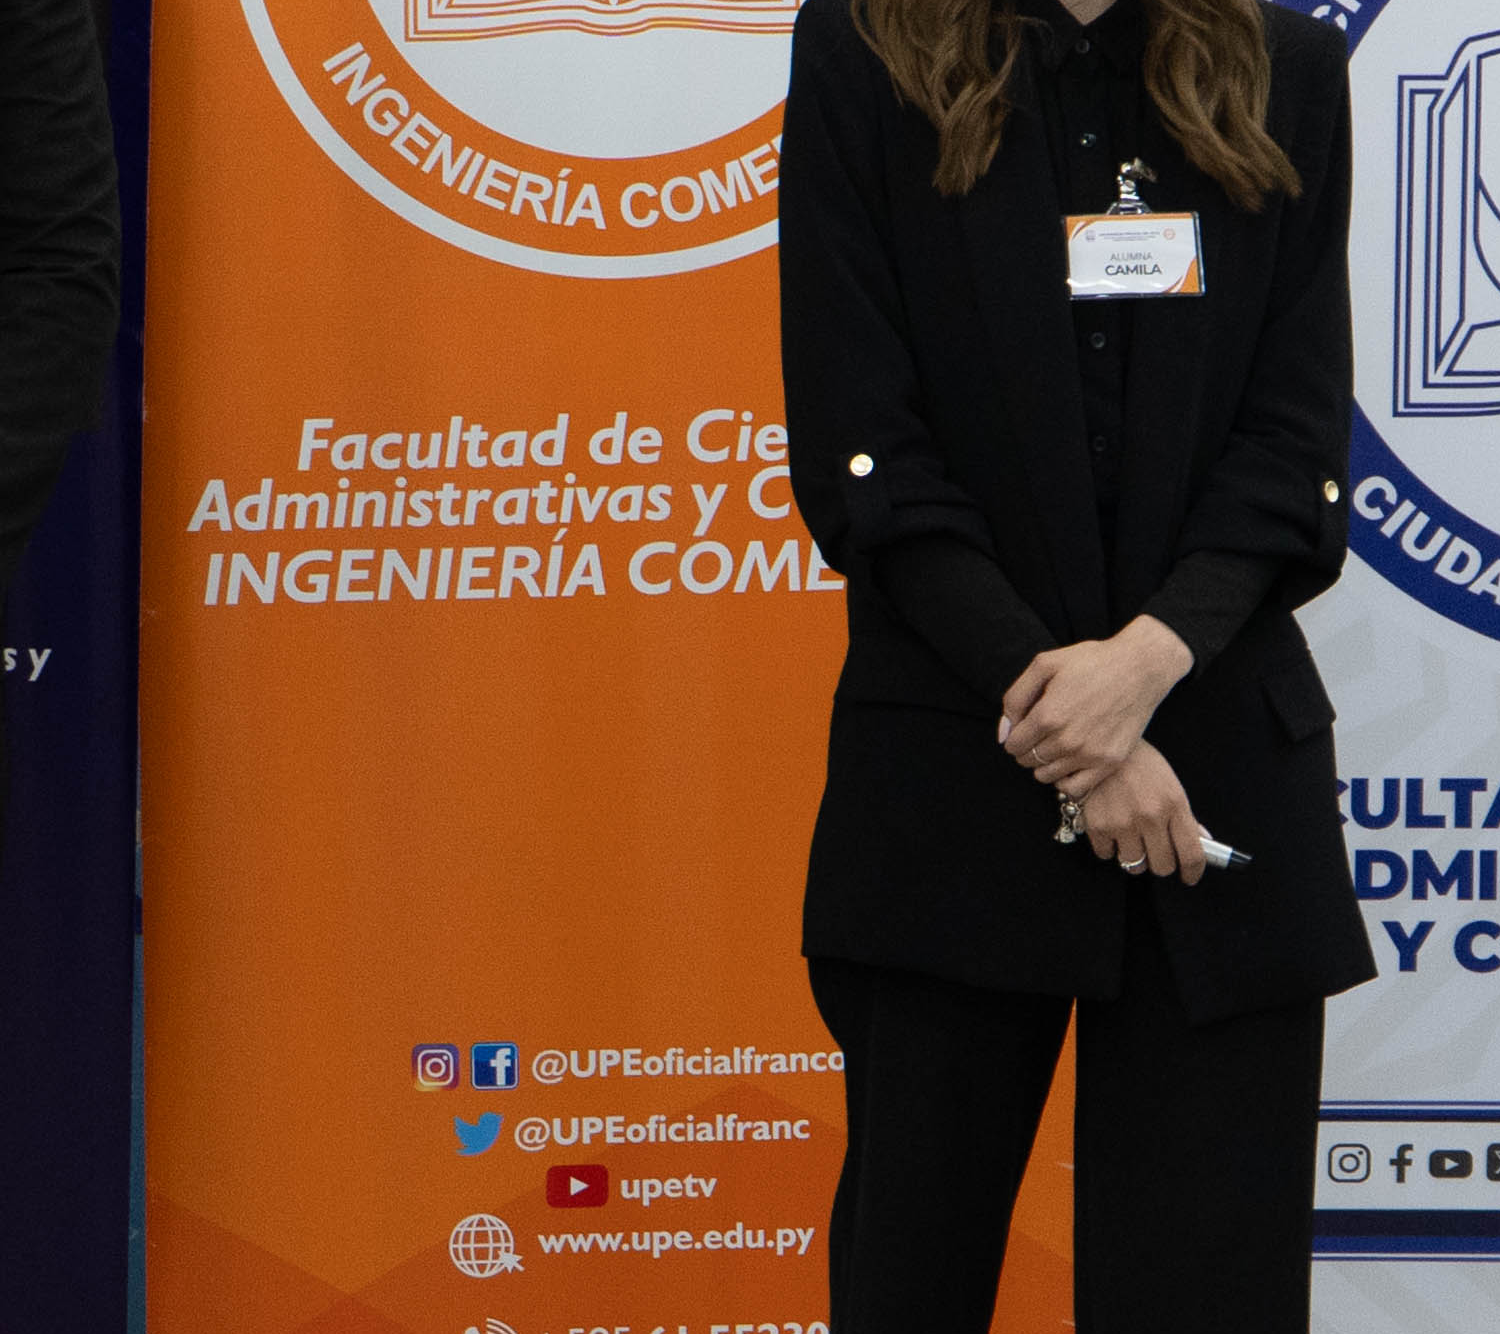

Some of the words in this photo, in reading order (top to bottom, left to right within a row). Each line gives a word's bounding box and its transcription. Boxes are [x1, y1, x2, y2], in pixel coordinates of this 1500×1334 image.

[322, 41, 608, 230] INGENIERÍA
[1105, 264, 1162, 276] CAMILA
[1110, 253, 1152, 261] ALUMNA
[298, 414, 569, 470] Facultad
[589, 412, 662, 465] de
[188, 473, 672, 531] Administrativas
[692, 484, 727, 537] y
[205, 528, 606, 605] INGENIERÍA
[29, 649, 51, 681] y
[1382, 921, 1435, 972] Y
[514, 1114, 810, 1152] @UPEoficialfranc
[621, 1174, 717, 1207] upetv
[538, 1222, 815, 1258] www.upe.edu.py
